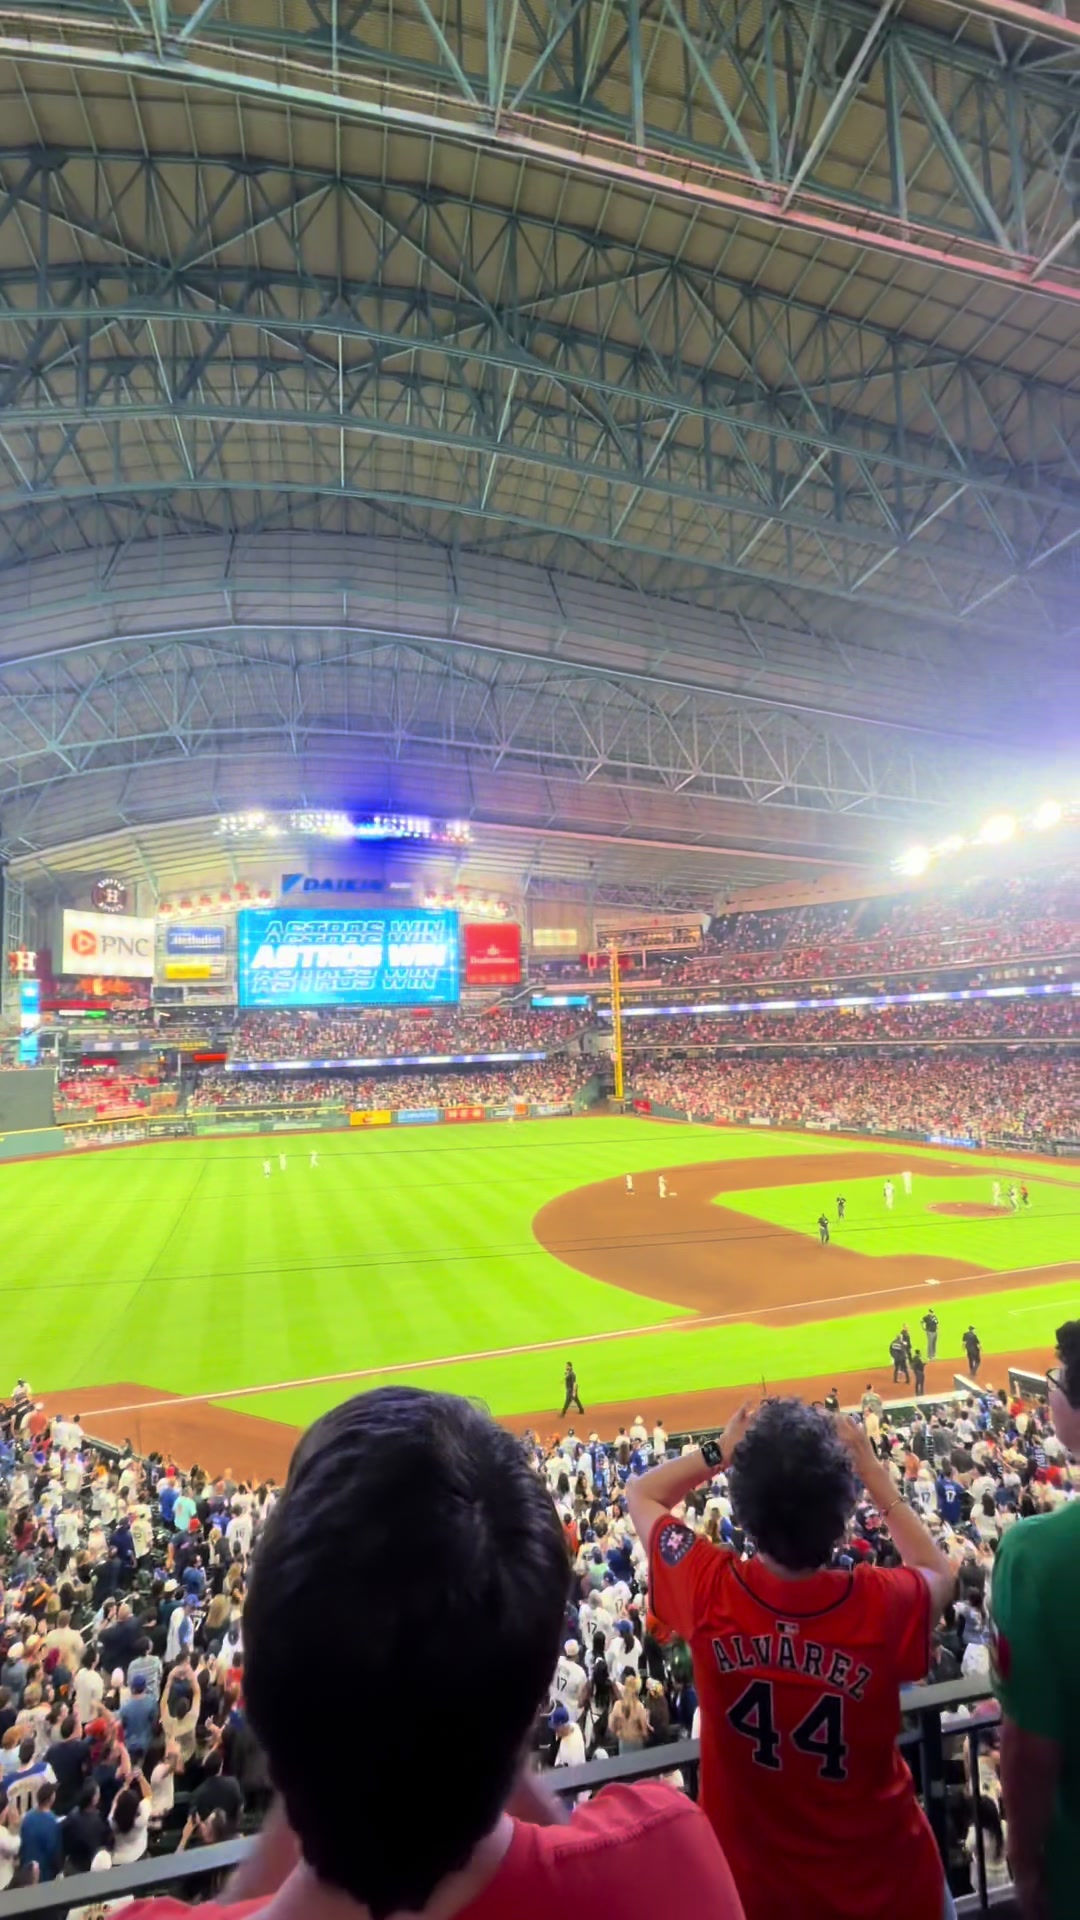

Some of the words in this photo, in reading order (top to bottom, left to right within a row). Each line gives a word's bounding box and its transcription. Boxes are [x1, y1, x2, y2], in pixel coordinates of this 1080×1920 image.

[101, 935, 149, 957] PNC
[251, 943, 384, 969] ASTROS
[387, 943, 447, 967] WIN
[586, 1620, 598, 1635] 17
[712, 1634, 872, 1702] ALVAREZ
[556, 1675, 568, 1692] 17
[726, 1679, 848, 1782] 44
